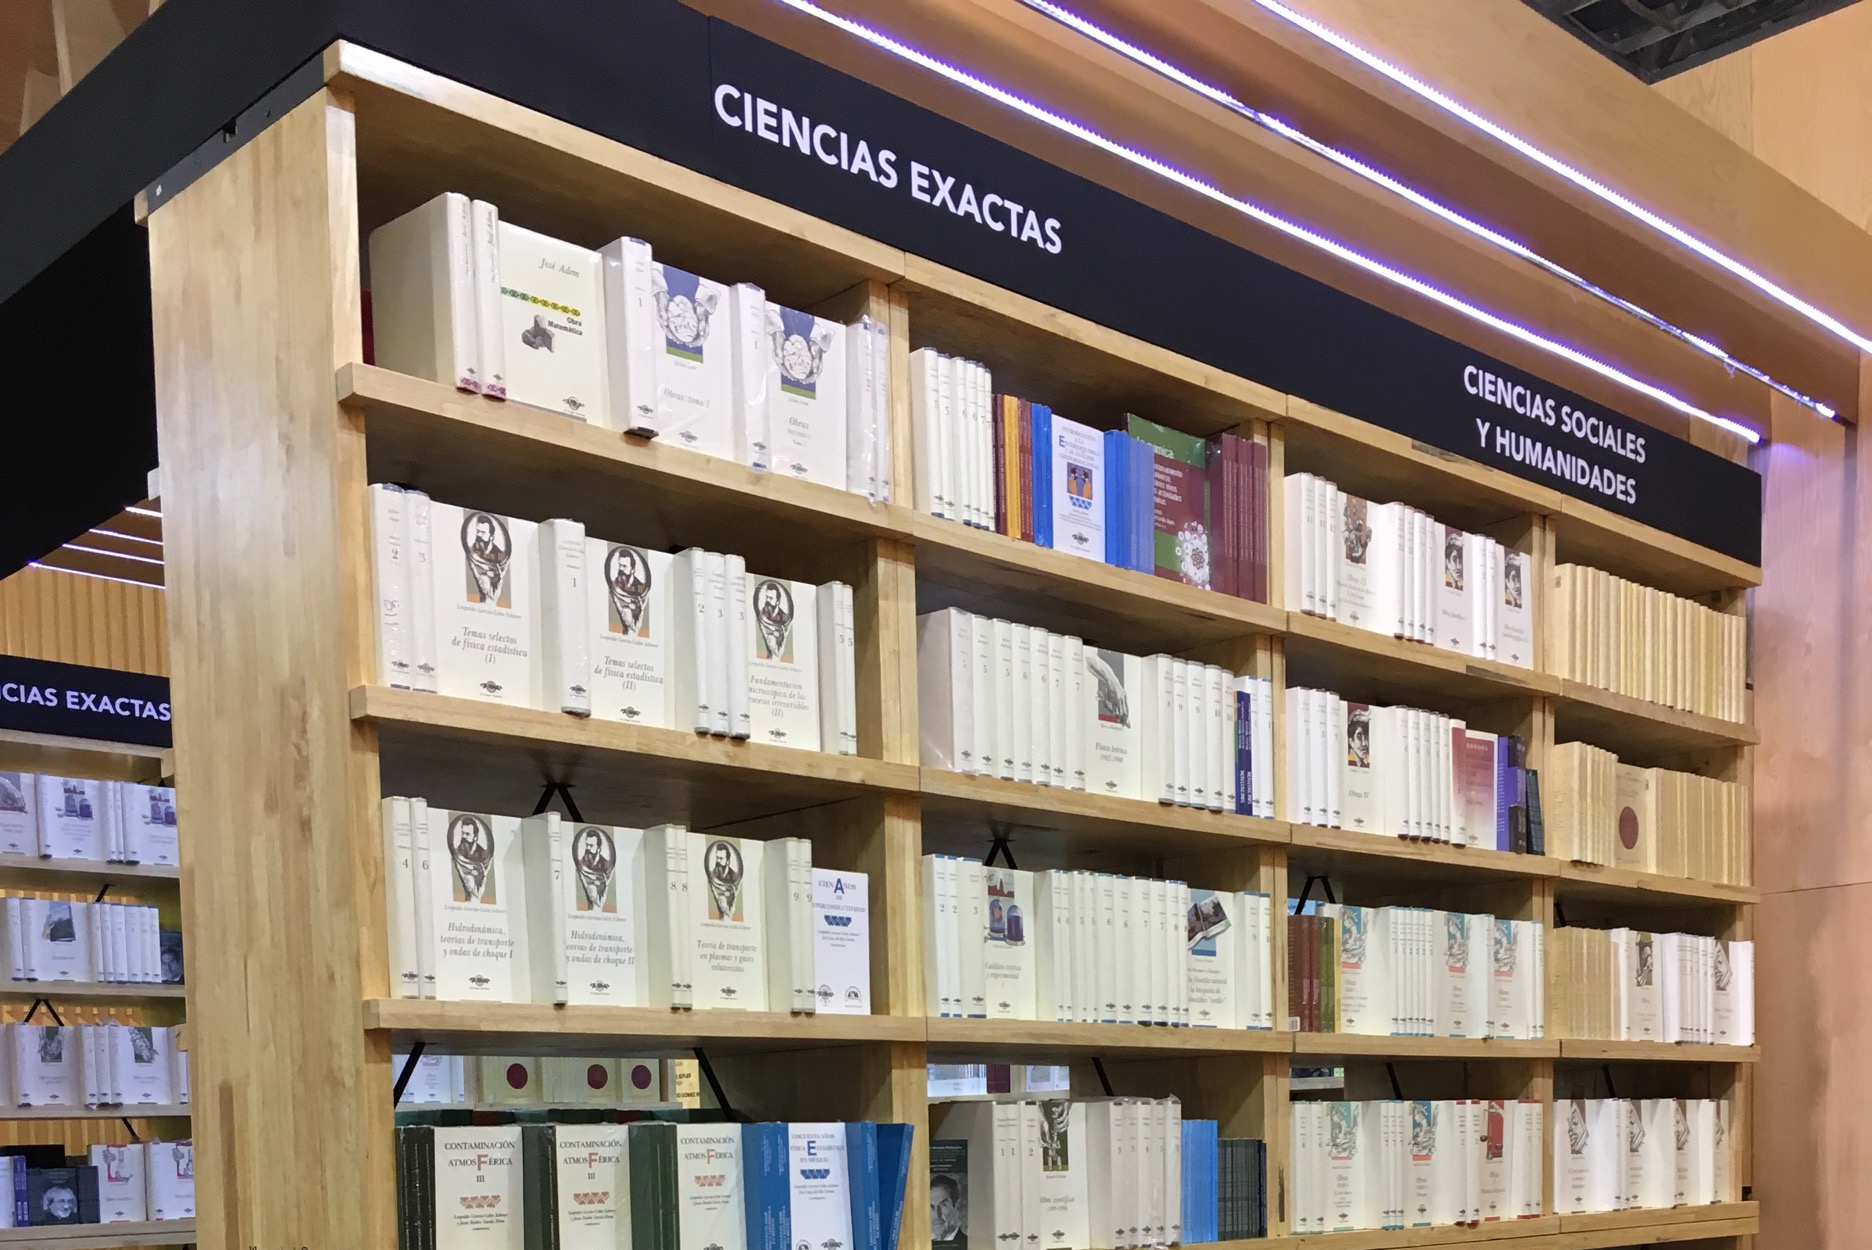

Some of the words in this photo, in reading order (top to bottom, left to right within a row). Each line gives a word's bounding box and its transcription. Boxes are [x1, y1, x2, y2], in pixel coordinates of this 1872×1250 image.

[714, 84, 898, 188] CIENCIAS
[910, 160, 1062, 254] EXACTAS
[539, 257, 556, 270] José
[558, 263, 580, 278] Adem
[567, 317, 582, 327] Obra
[1464, 365, 1556, 426] CIENCIAS
[1561, 405, 1646, 463] SOCIALES
[1476, 417, 1490, 447] Y
[1496, 426, 1636, 504] HUMANIDADES
[462, 626, 486, 639] Temas
[0, 683, 57, 706] CIAS
[66, 690, 171, 721] EXACTAS
[402, 858, 409, 869] 4
[422, 859, 429, 870] 6
[444, 1140, 515, 1150] CONTAMINACIÓN
[559, 1139, 622, 1149] CONTAMINACIÓN
[680, 1136, 734, 1145] CONTAMINACIÓN
[448, 1154, 513, 1171] ATMOSFÉRICA
